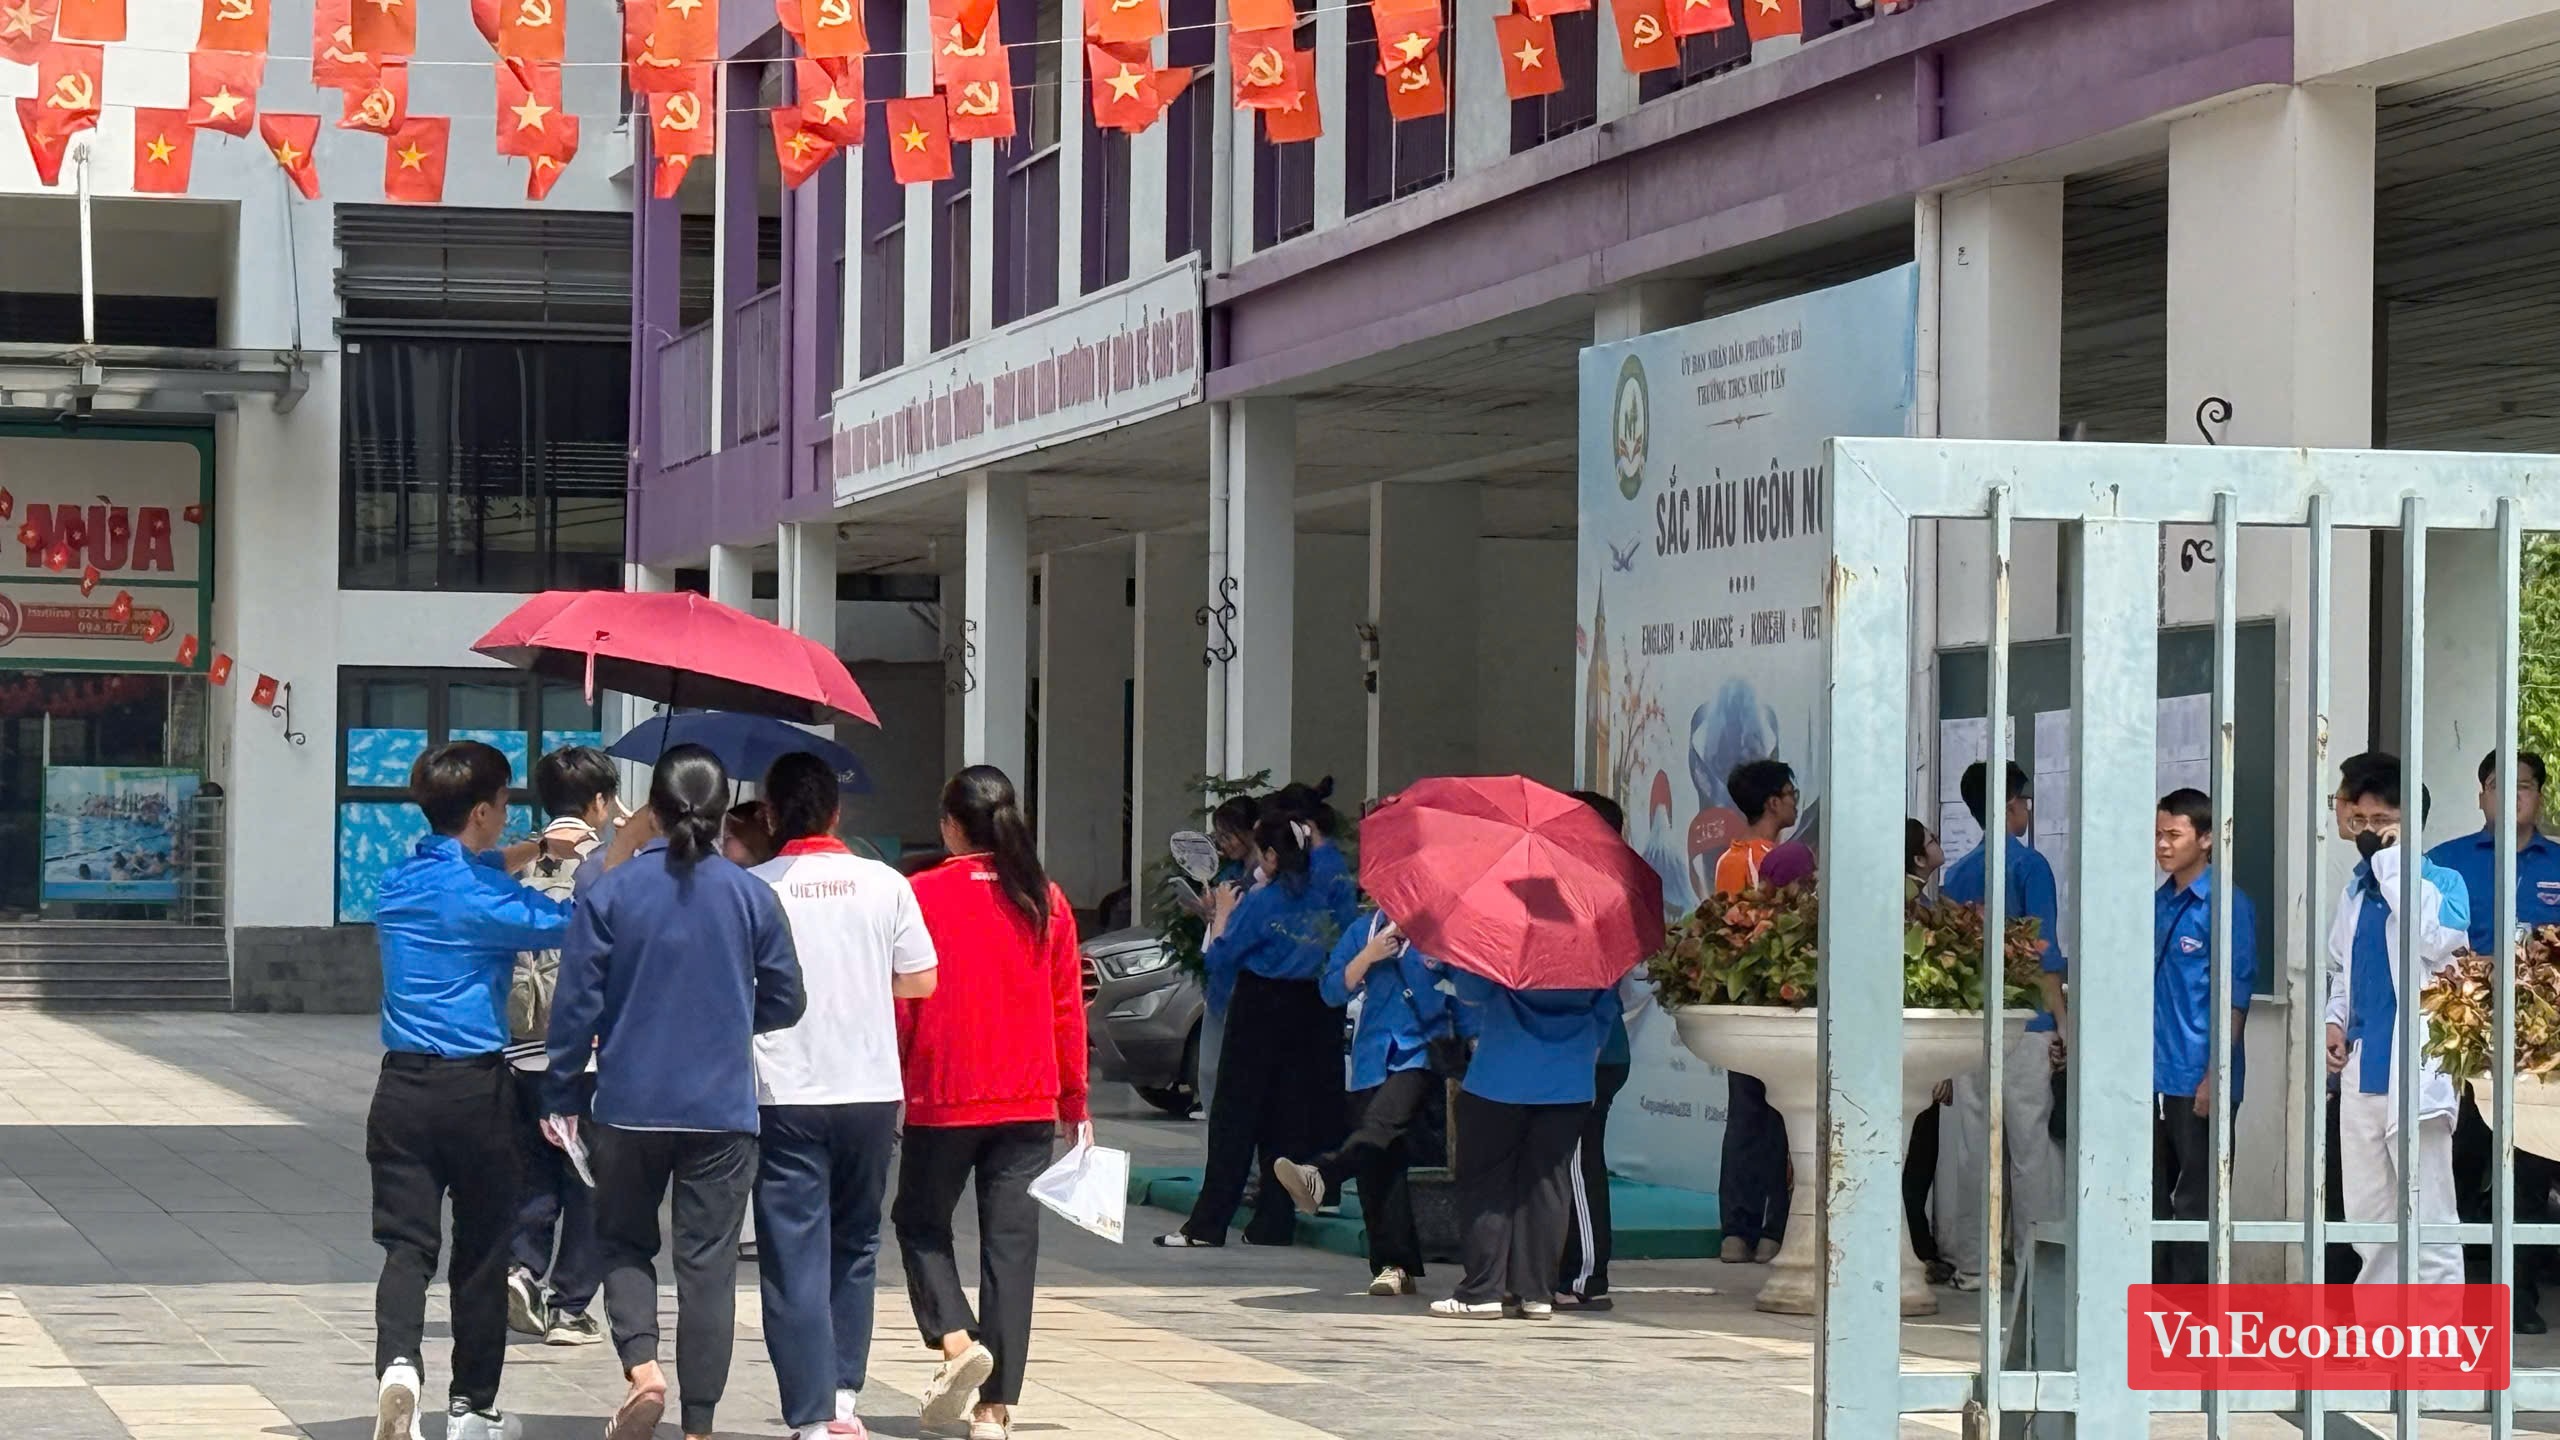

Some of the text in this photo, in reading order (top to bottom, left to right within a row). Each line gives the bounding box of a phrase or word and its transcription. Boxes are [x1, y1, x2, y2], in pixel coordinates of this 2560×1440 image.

[26, 495, 174, 571] MÙA
[1656, 464, 1690, 557] SẮC
[1697, 467, 1736, 551] MÀU
[1743, 456, 1794, 544] NGÔN
[1641, 623, 1674, 656] ENGLISH
[1690, 614, 1734, 652] JAPANESE
[1751, 609, 1785, 646] KOREAN
